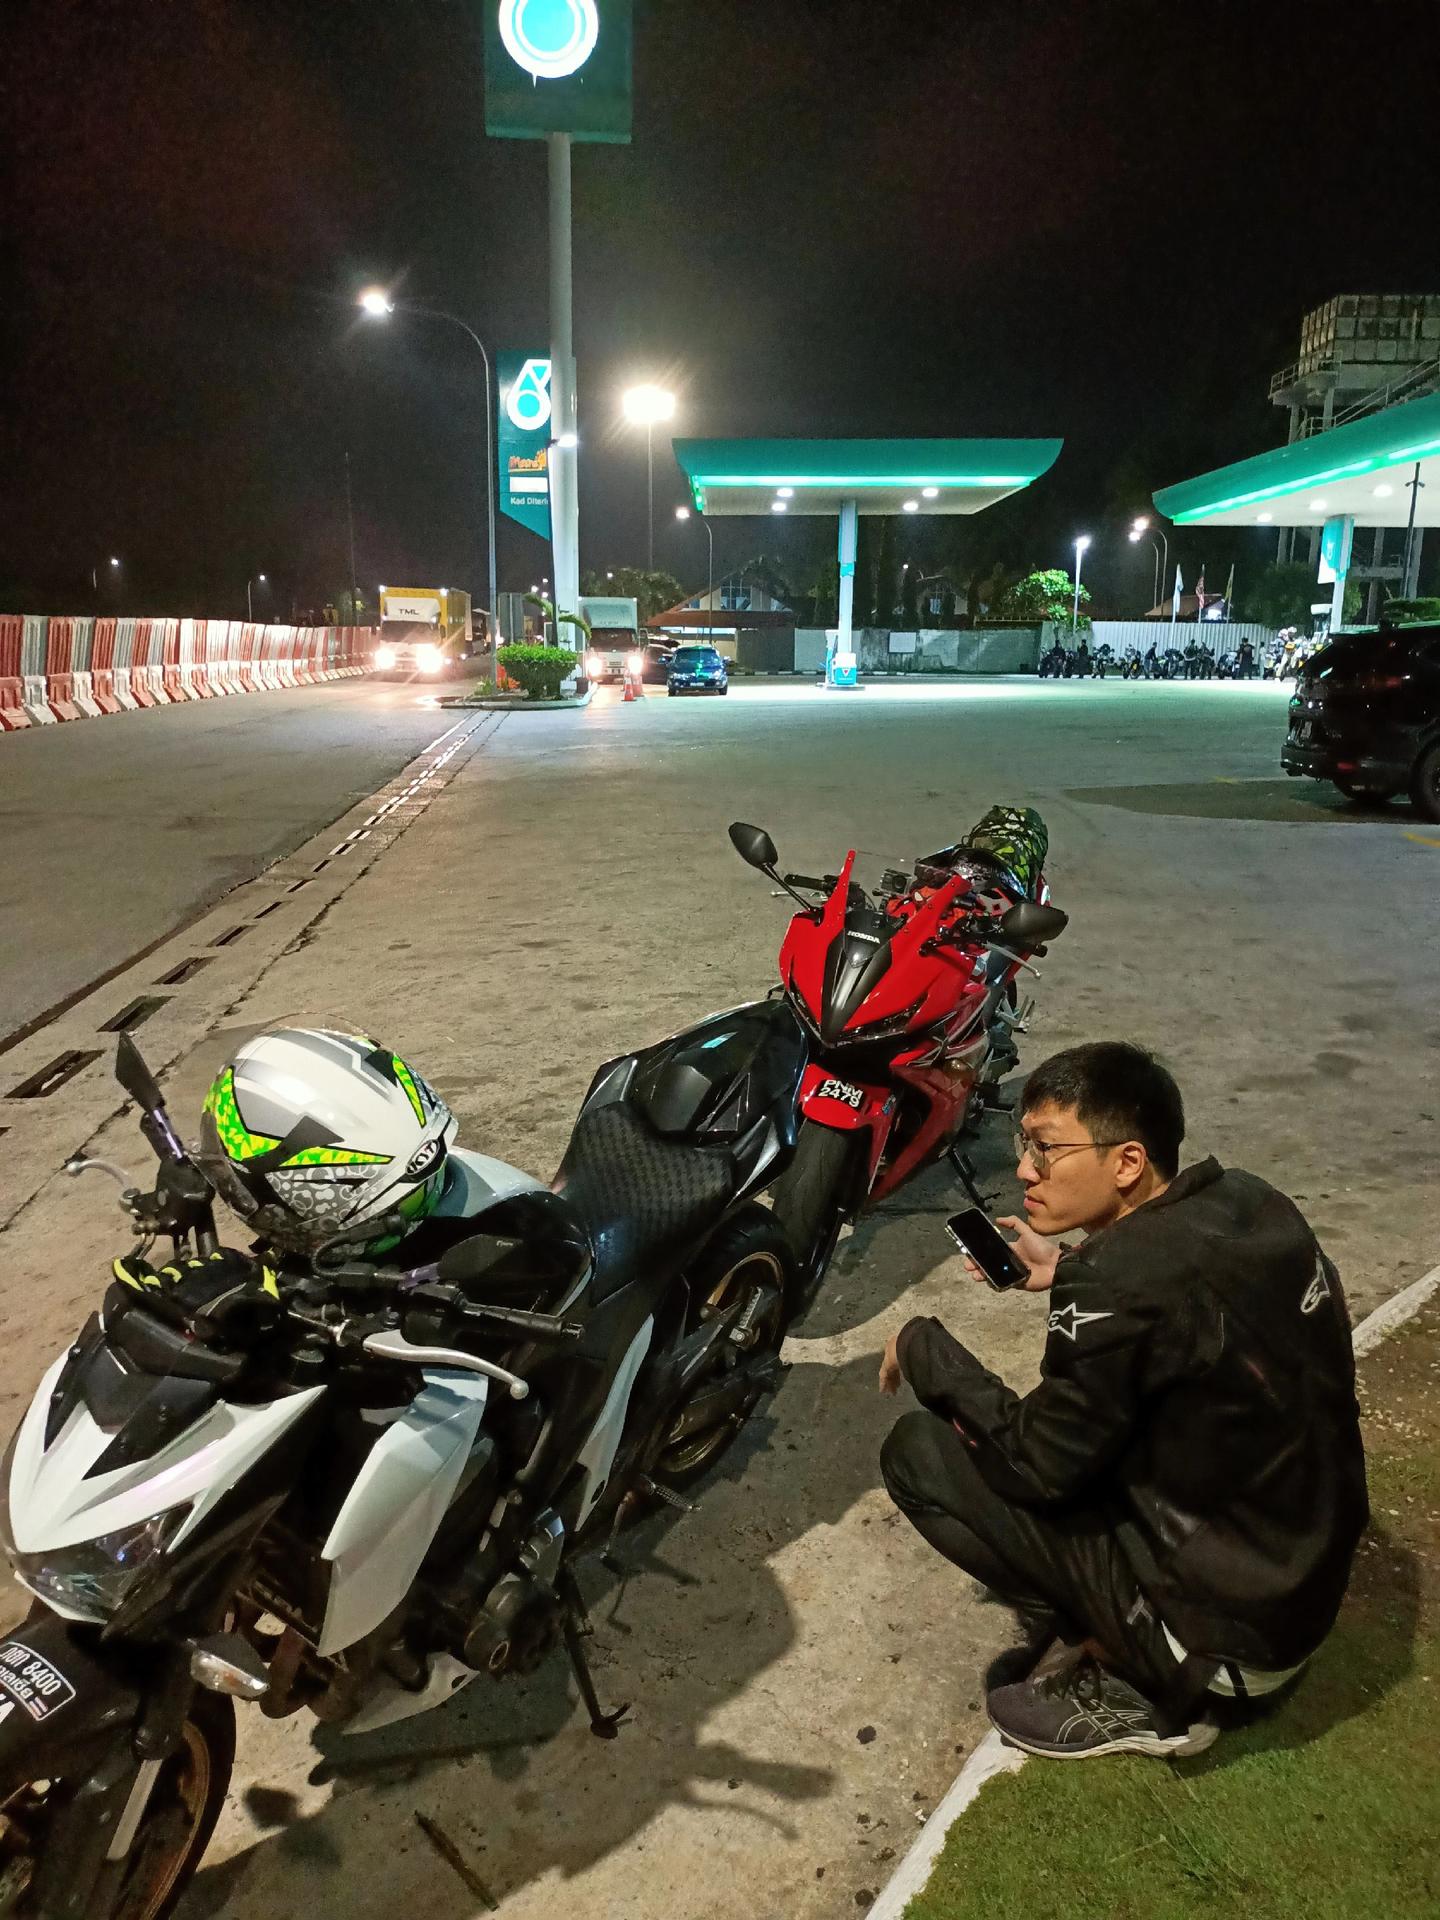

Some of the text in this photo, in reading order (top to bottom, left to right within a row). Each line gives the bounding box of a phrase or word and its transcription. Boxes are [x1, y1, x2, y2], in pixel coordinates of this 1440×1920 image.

[847, 930, 880, 944] HONDA
[818, 1087, 860, 1108] 2479
[406, 1139, 439, 1174] KYT
[22, 1661, 61, 1696] 8400
